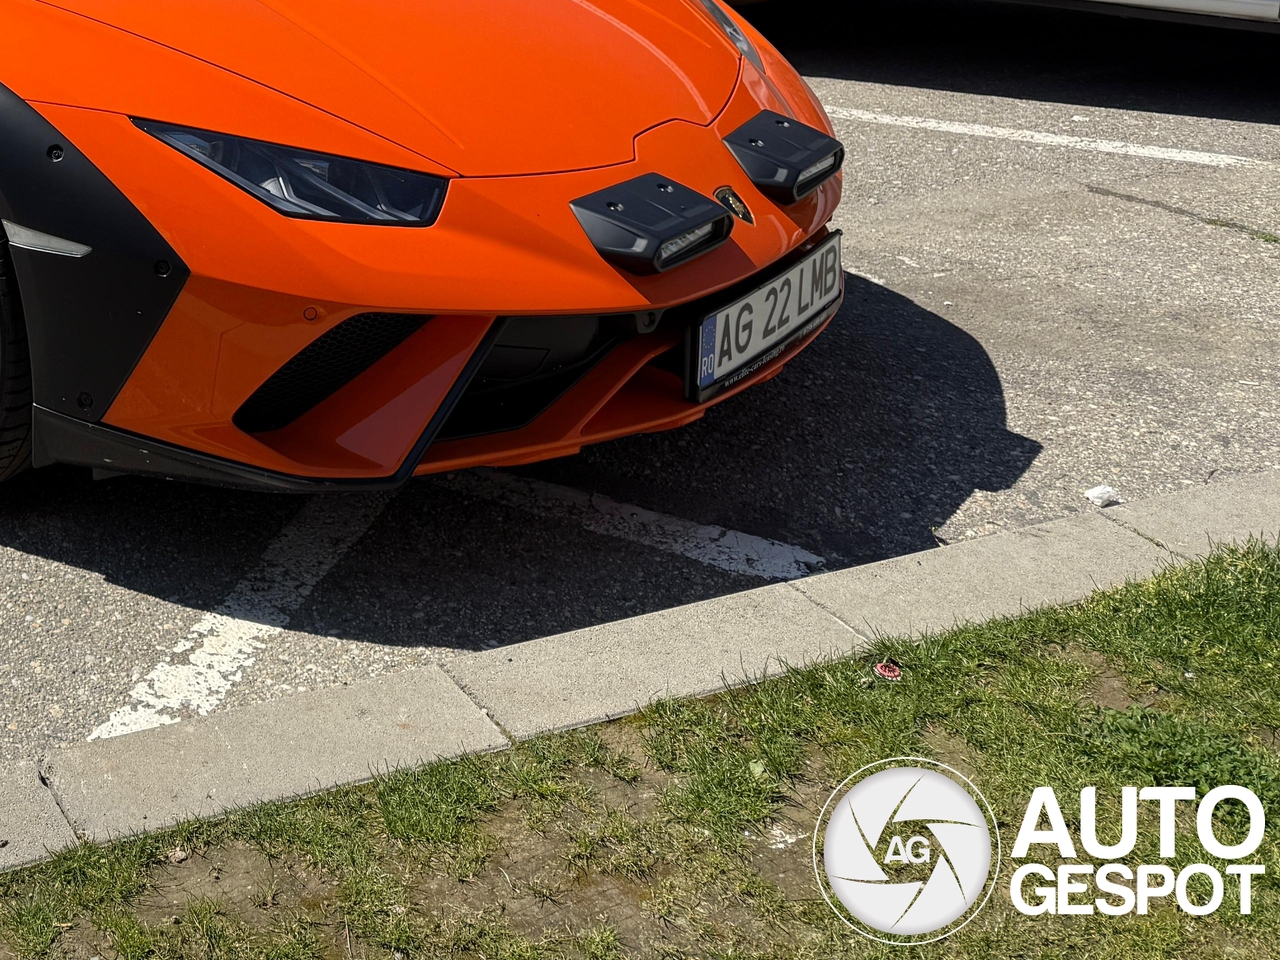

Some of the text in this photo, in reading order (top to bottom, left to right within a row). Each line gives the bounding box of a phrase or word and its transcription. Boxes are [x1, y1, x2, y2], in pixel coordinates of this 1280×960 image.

[701, 353, 714, 378] RO
[717, 302, 754, 368] AG
[762, 277, 792, 340] 22
[797, 244, 838, 317] LMB
